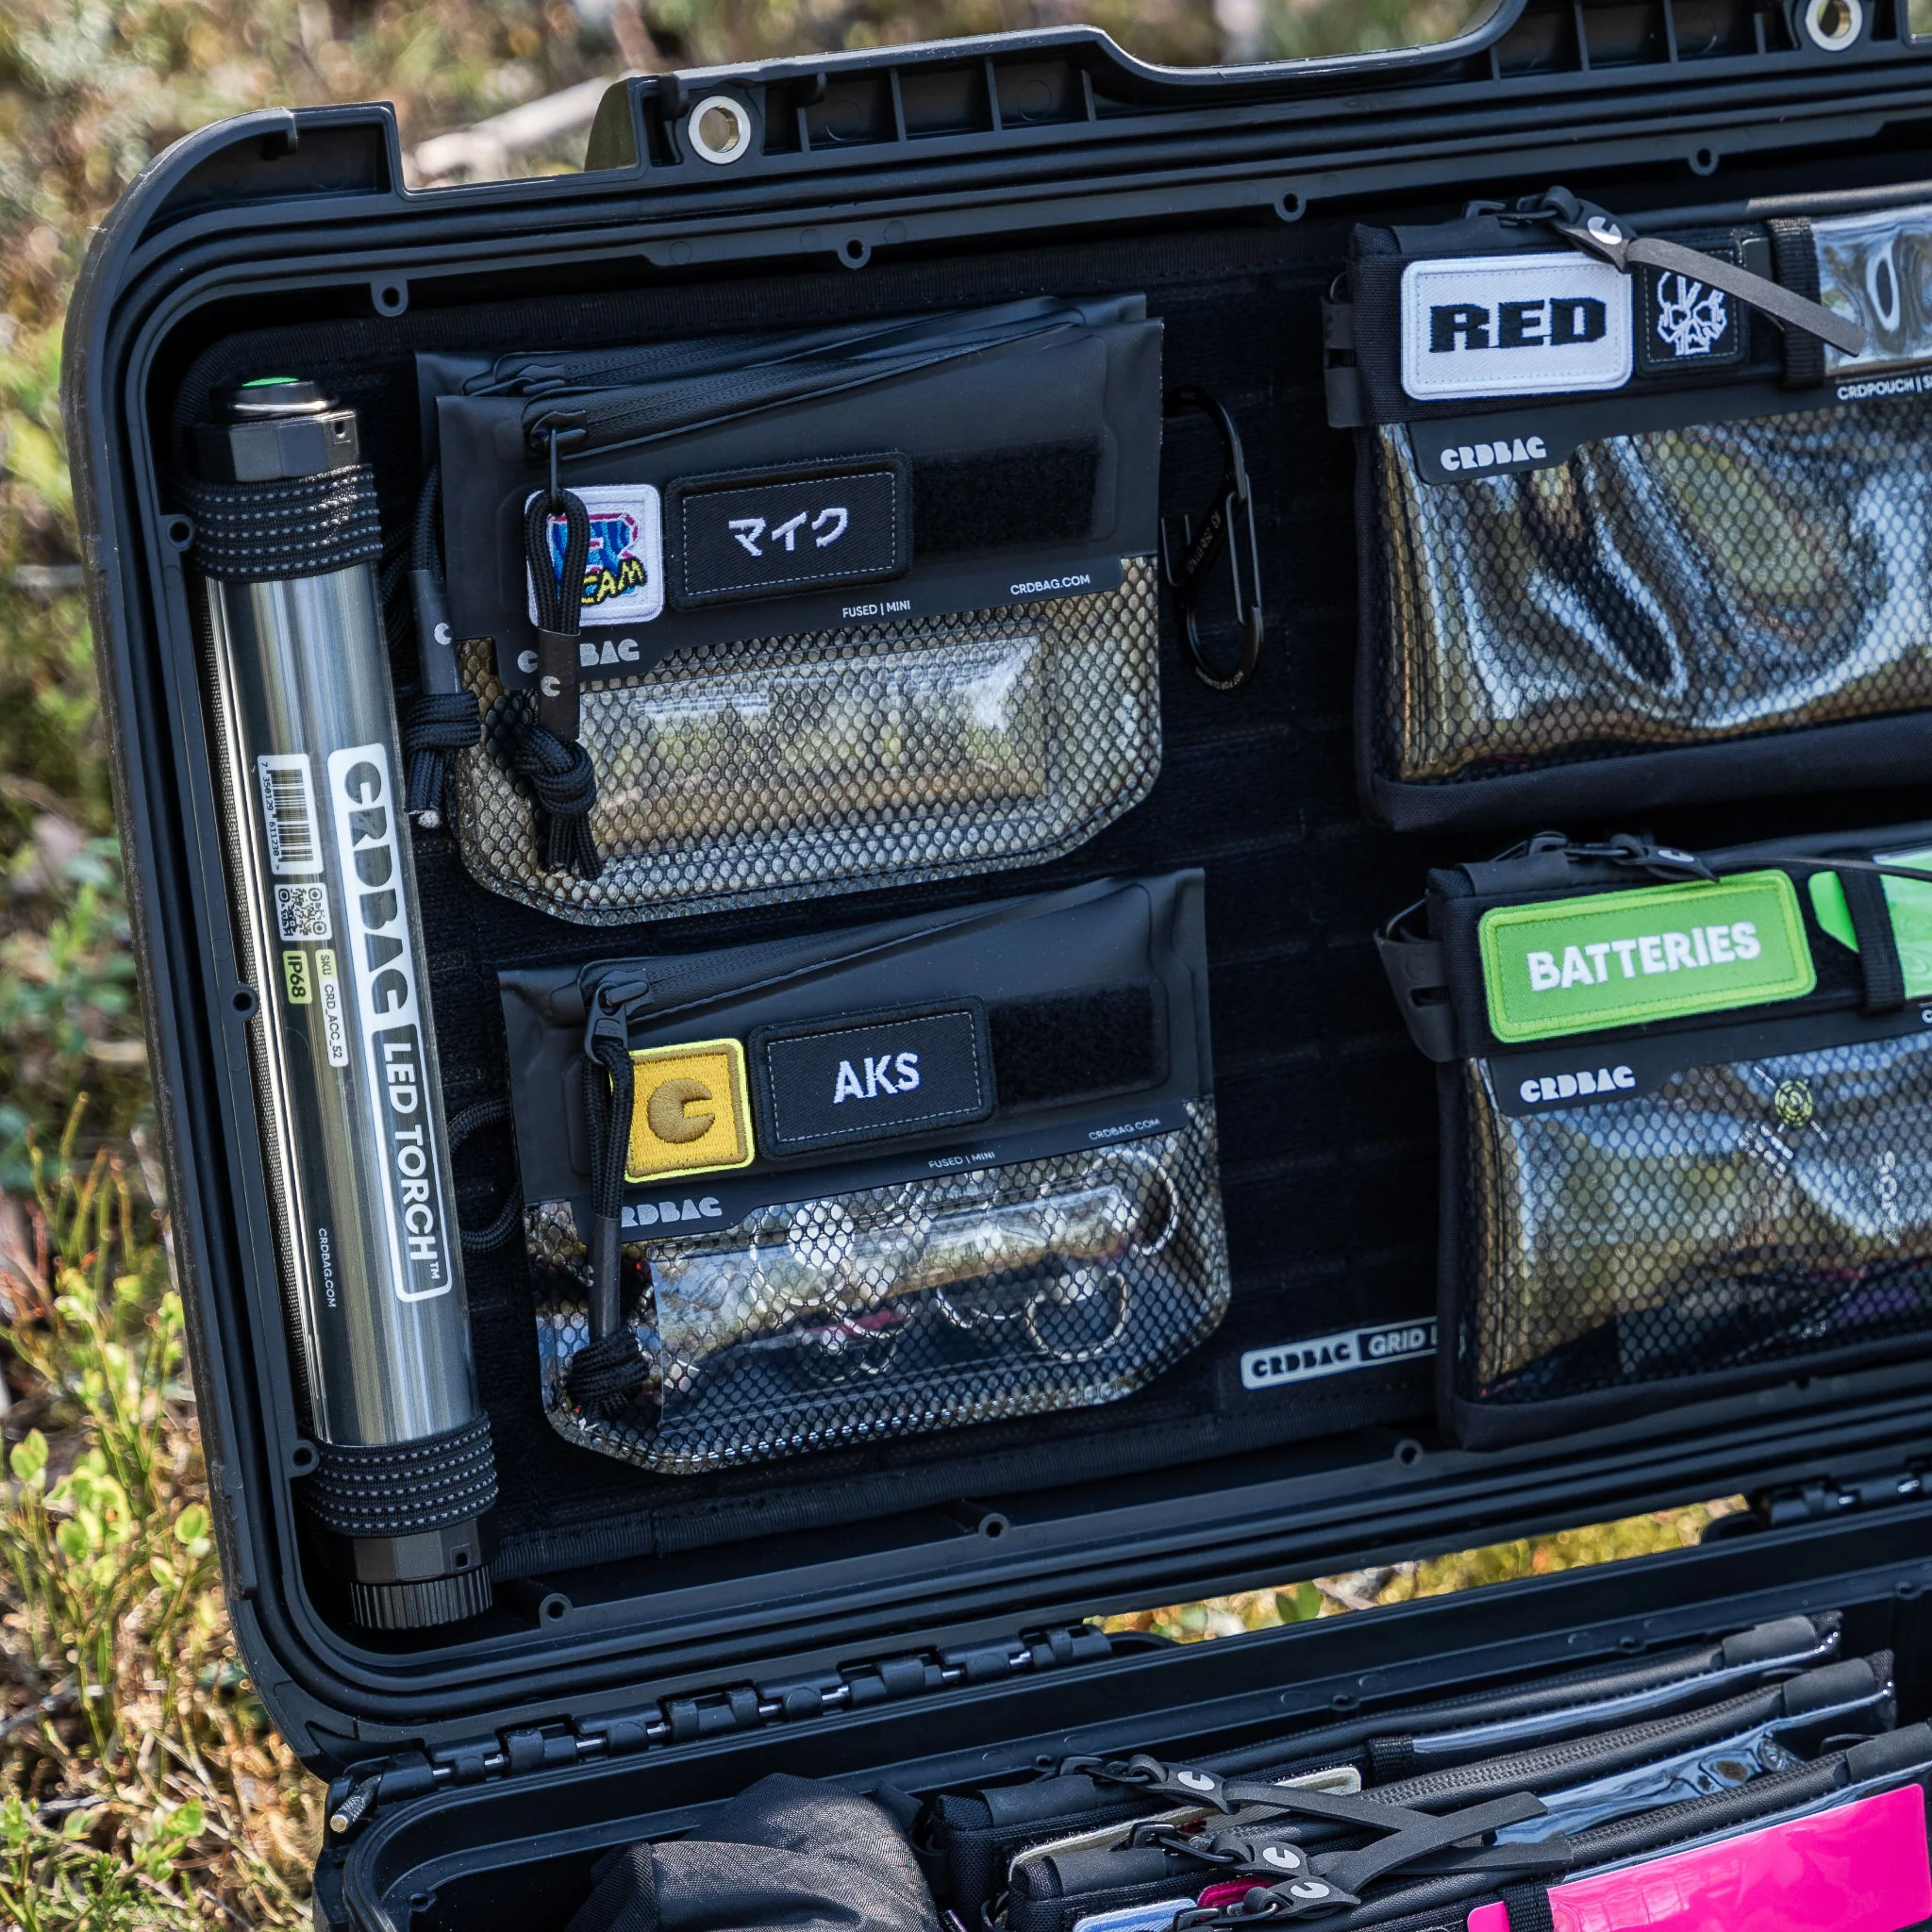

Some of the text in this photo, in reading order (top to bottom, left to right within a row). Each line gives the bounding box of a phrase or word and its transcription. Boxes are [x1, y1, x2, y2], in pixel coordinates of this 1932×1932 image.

[1429, 297, 1607, 354] RED
[1837, 377, 1914, 401] CRDPOUCH
[728, 507, 848, 557] マイク
[1010, 574, 1091, 595] CRDBAG.COM
[842, 603, 877, 618] FUSED
[886, 600, 911, 613] MINI
[518, 639, 639, 673] CBAG
[286, 956, 308, 998] IP68
[1526, 923, 1761, 992] BATTERIES
[320, 955, 341, 1059] SKU CRD_ACC_52
[384, 1041, 418, 1112] LED
[833, 1051, 921, 1105] AKS
[1088, 1118, 1161, 1141] CRDBAG.COM
[928, 1156, 964, 1170] FUSED
[972, 1150, 995, 1164] MINI
[318, 1227, 336, 1308] CRDBAG.COM
[1368, 1328, 1426, 1357] GRID
